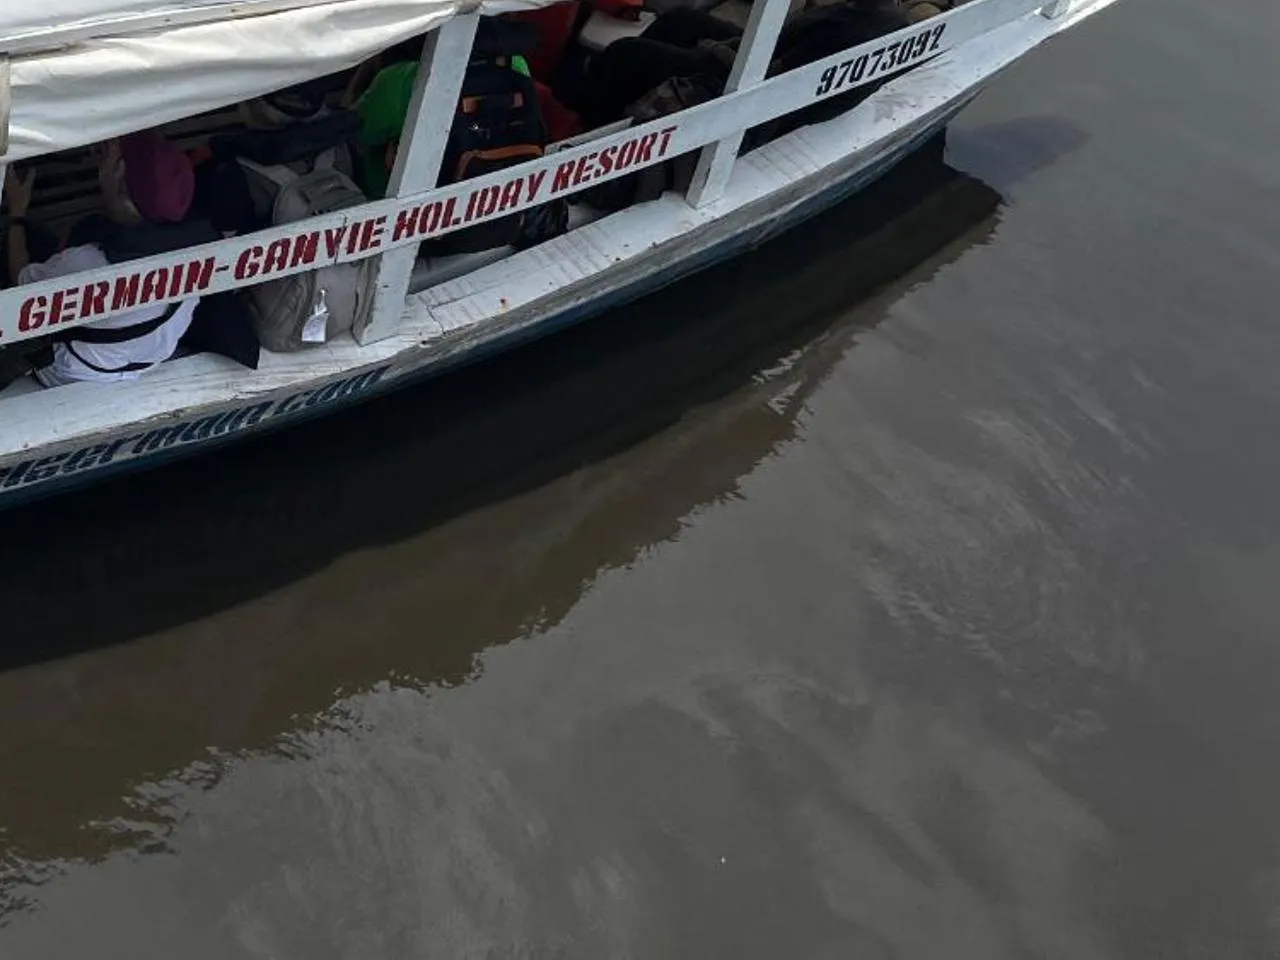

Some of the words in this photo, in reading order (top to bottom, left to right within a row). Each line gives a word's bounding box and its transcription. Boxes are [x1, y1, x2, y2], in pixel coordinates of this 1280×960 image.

[815, 22, 947, 96] 97073092
[392, 169, 547, 242] HOLIDAY
[550, 125, 678, 195] RESORT
